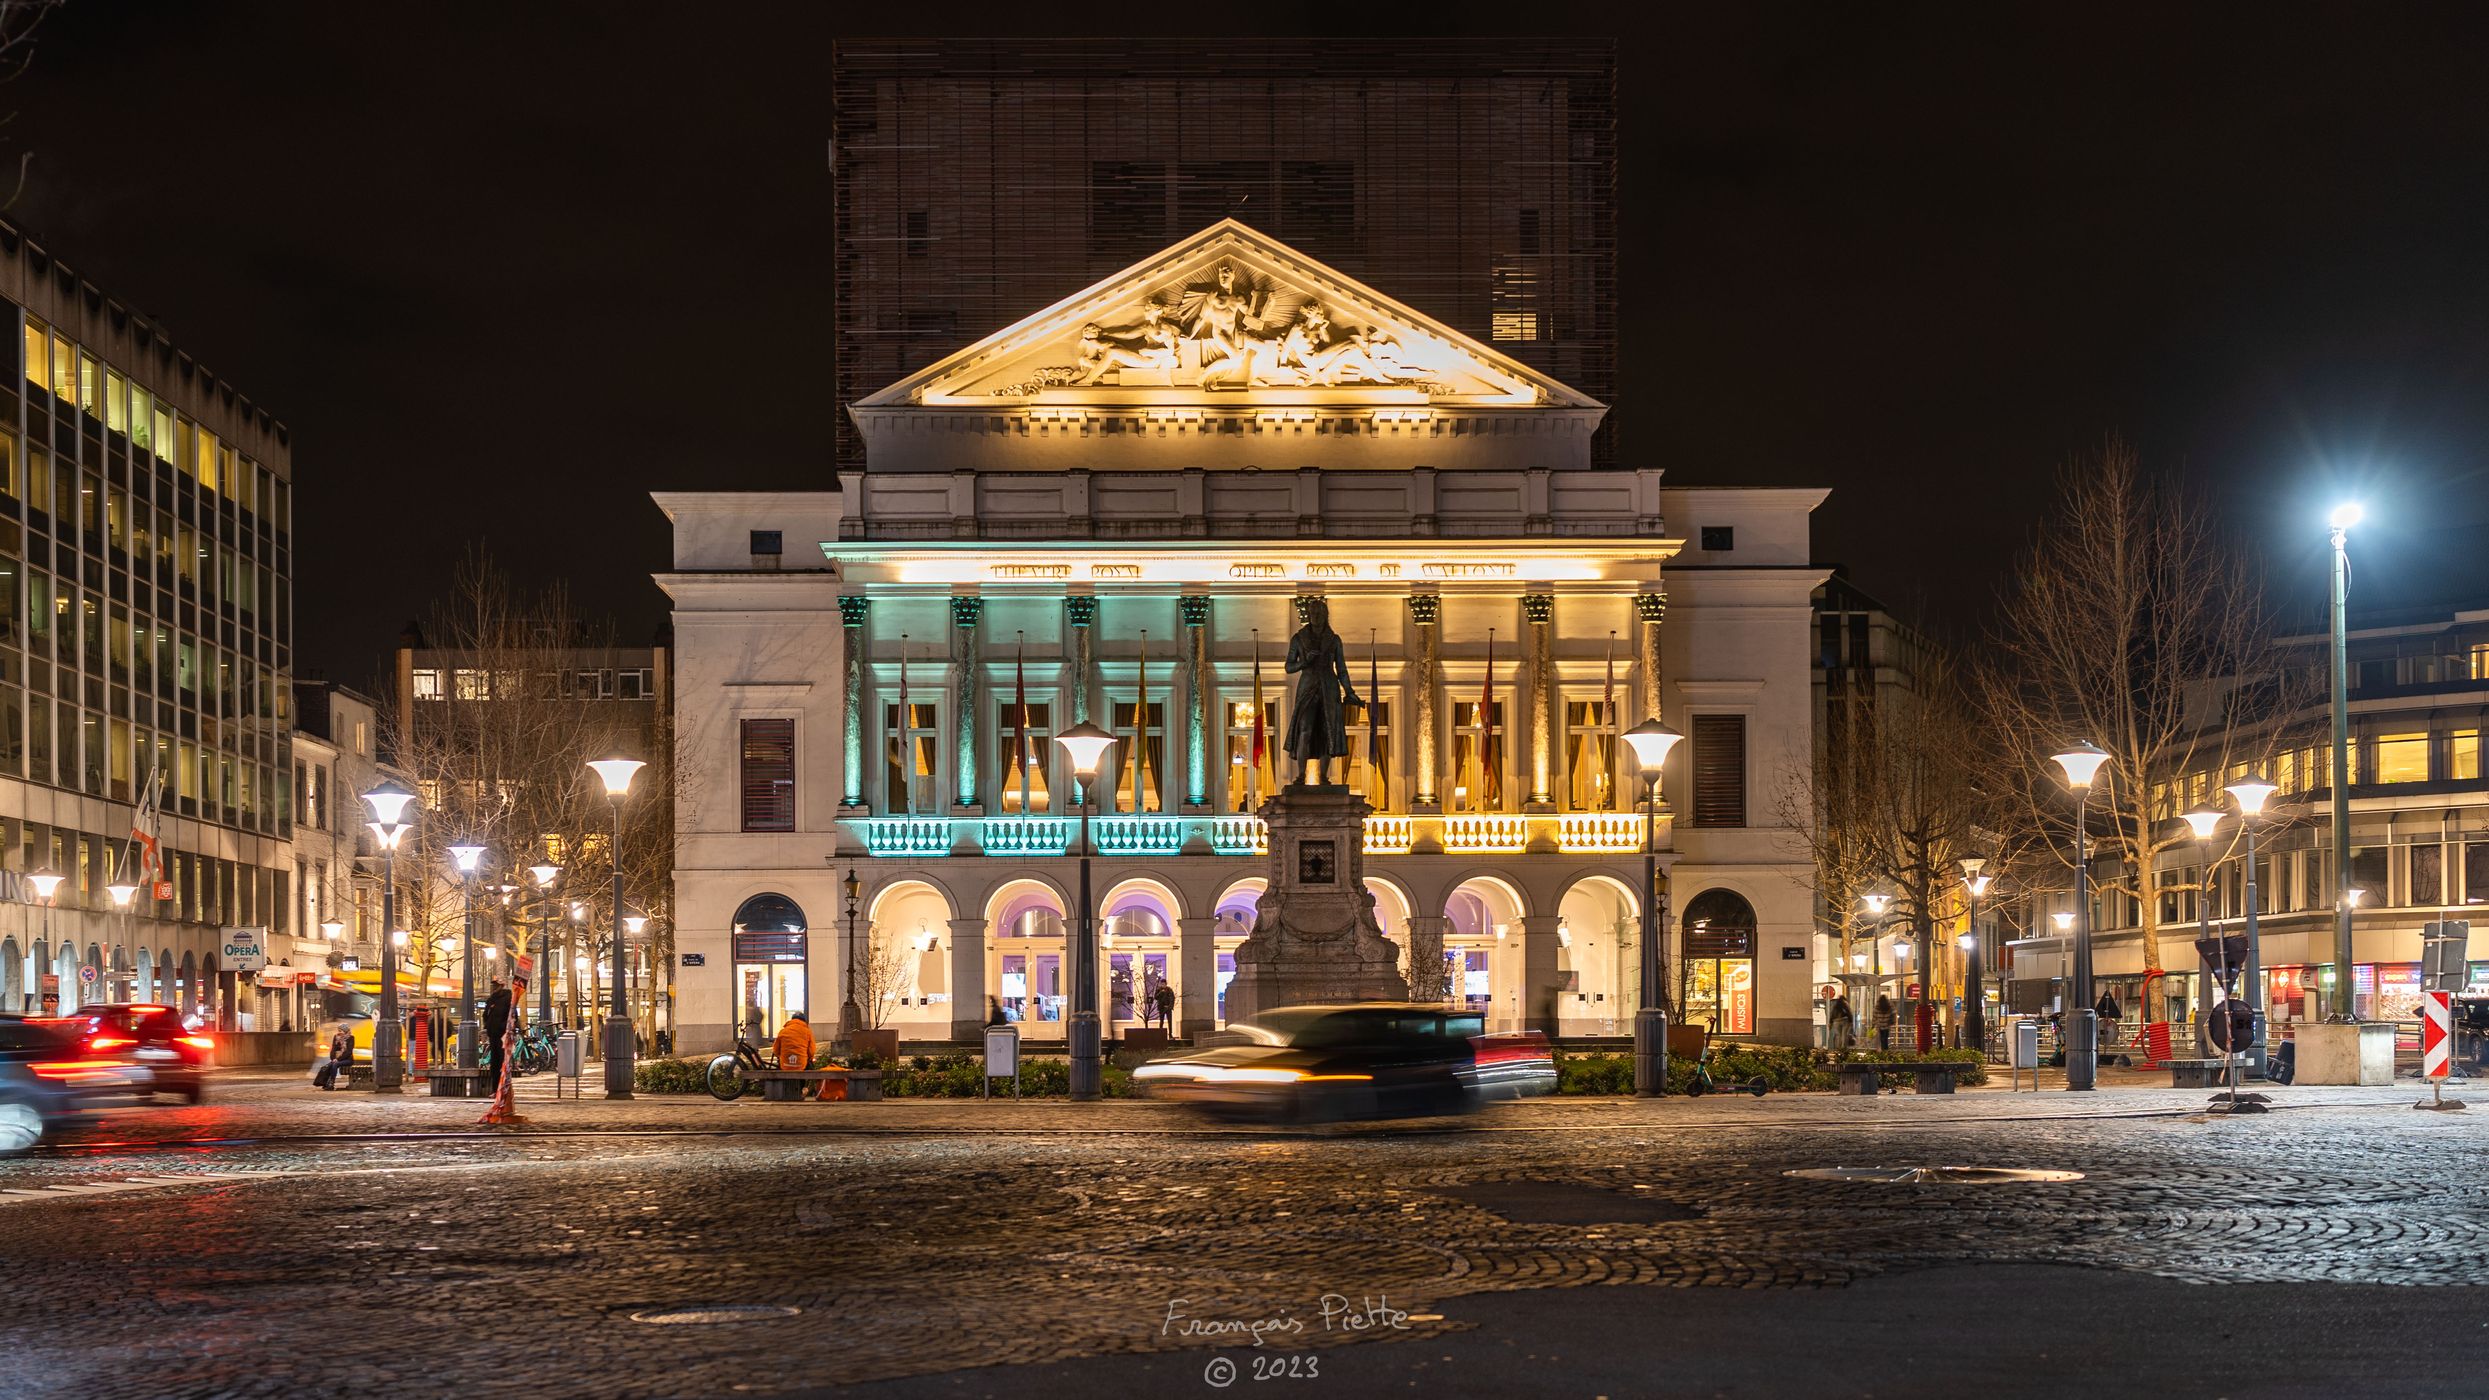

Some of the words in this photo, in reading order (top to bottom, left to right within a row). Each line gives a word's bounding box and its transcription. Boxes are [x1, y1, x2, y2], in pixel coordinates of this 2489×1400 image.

[1091, 564, 1142, 578] ROYAL
[1306, 563, 1355, 578] ROYAL
[1379, 563, 1401, 578] DE
[1421, 563, 1516, 578] WALLONIE
[224, 944, 260, 956] OPERA
[1737, 994, 1746, 1030] MUSIQ3
